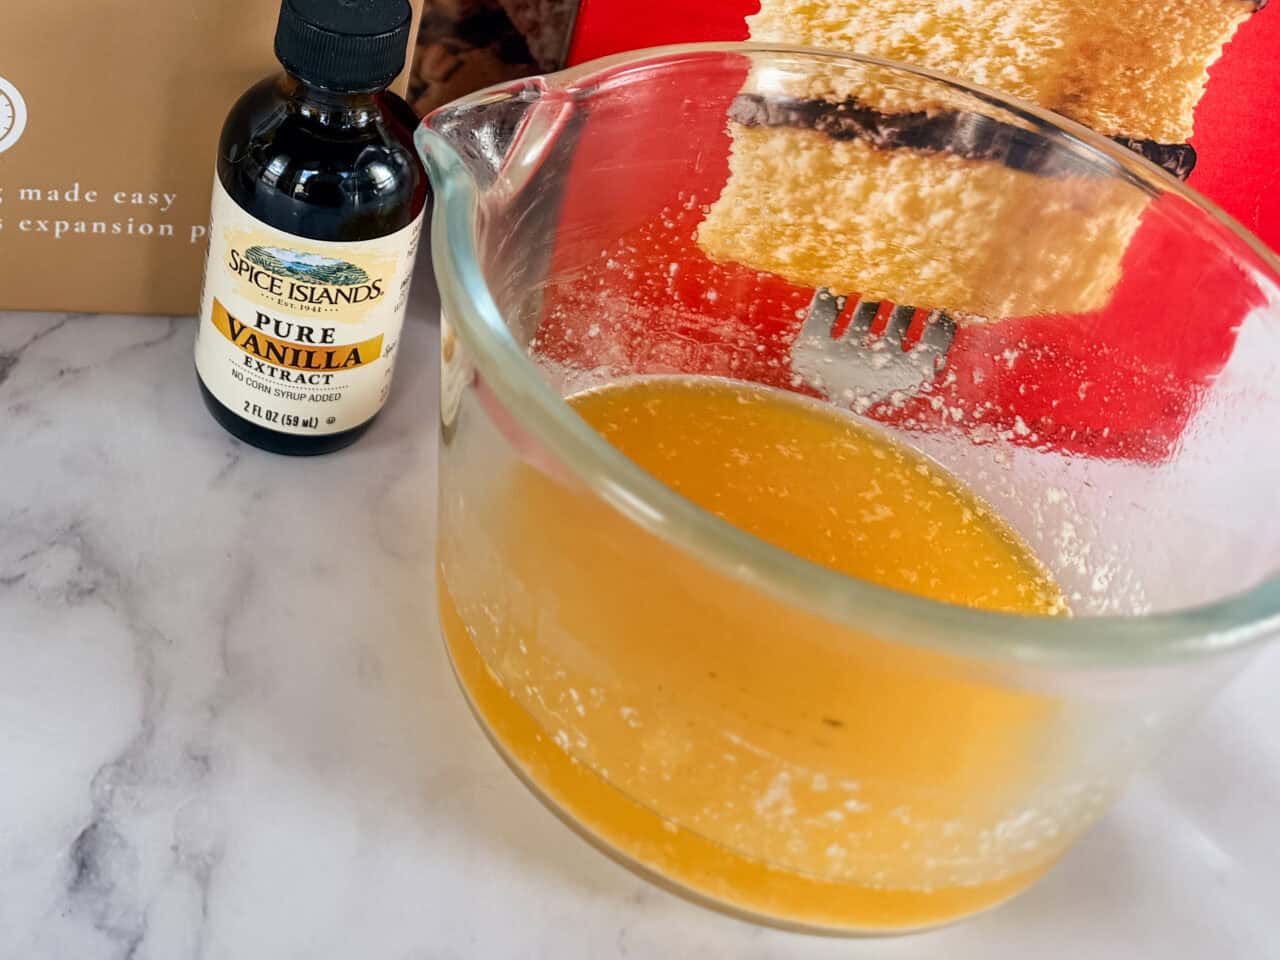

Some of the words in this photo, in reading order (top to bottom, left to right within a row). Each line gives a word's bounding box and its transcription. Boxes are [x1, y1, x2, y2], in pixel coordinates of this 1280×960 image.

[18, 181, 99, 204] made
[113, 189, 178, 212] easy
[18, 215, 175, 239] expansion
[228, 249, 283, 297] SPICE
[288, 278, 384, 306] ISLANDS
[224, 314, 362, 371] VANILLA
[254, 310, 336, 344] PURE
[231, 368, 244, 382] NO
[245, 376, 271, 395] CORN
[273, 388, 307, 401] SYRUP
[308, 392, 342, 403] ADDED
[243, 355, 335, 386] EXTRACT
[243, 400, 250, 412] 2
[252, 403, 264, 419] FL
[265, 409, 280, 423] OZ
[281, 412, 300, 428] (59
